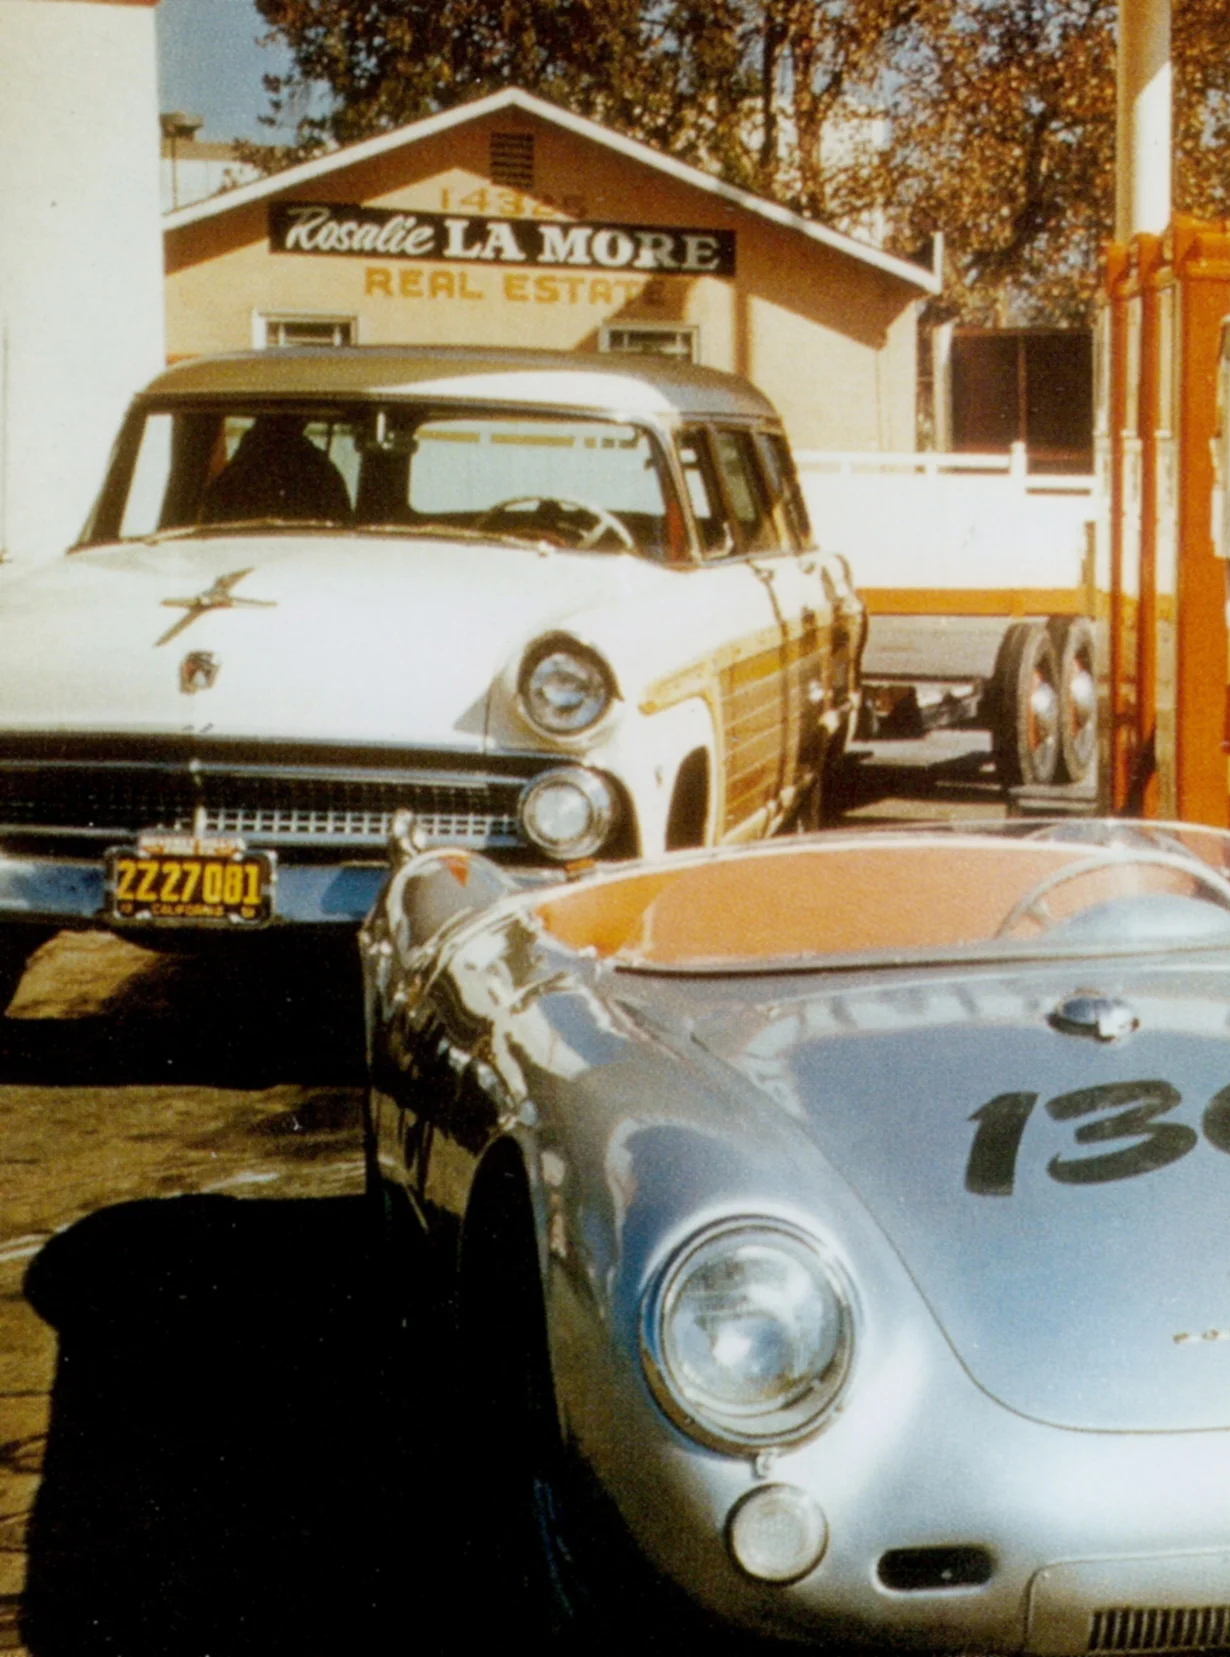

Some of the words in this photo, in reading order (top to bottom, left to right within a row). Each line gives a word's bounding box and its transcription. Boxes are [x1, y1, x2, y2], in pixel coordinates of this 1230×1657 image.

[285, 206, 436, 256] Rosalie
[443, 218, 526, 262] LA
[537, 225, 721, 272] MORE
[364, 266, 484, 299] REAL
[503, 273, 666, 306] ESTATE
